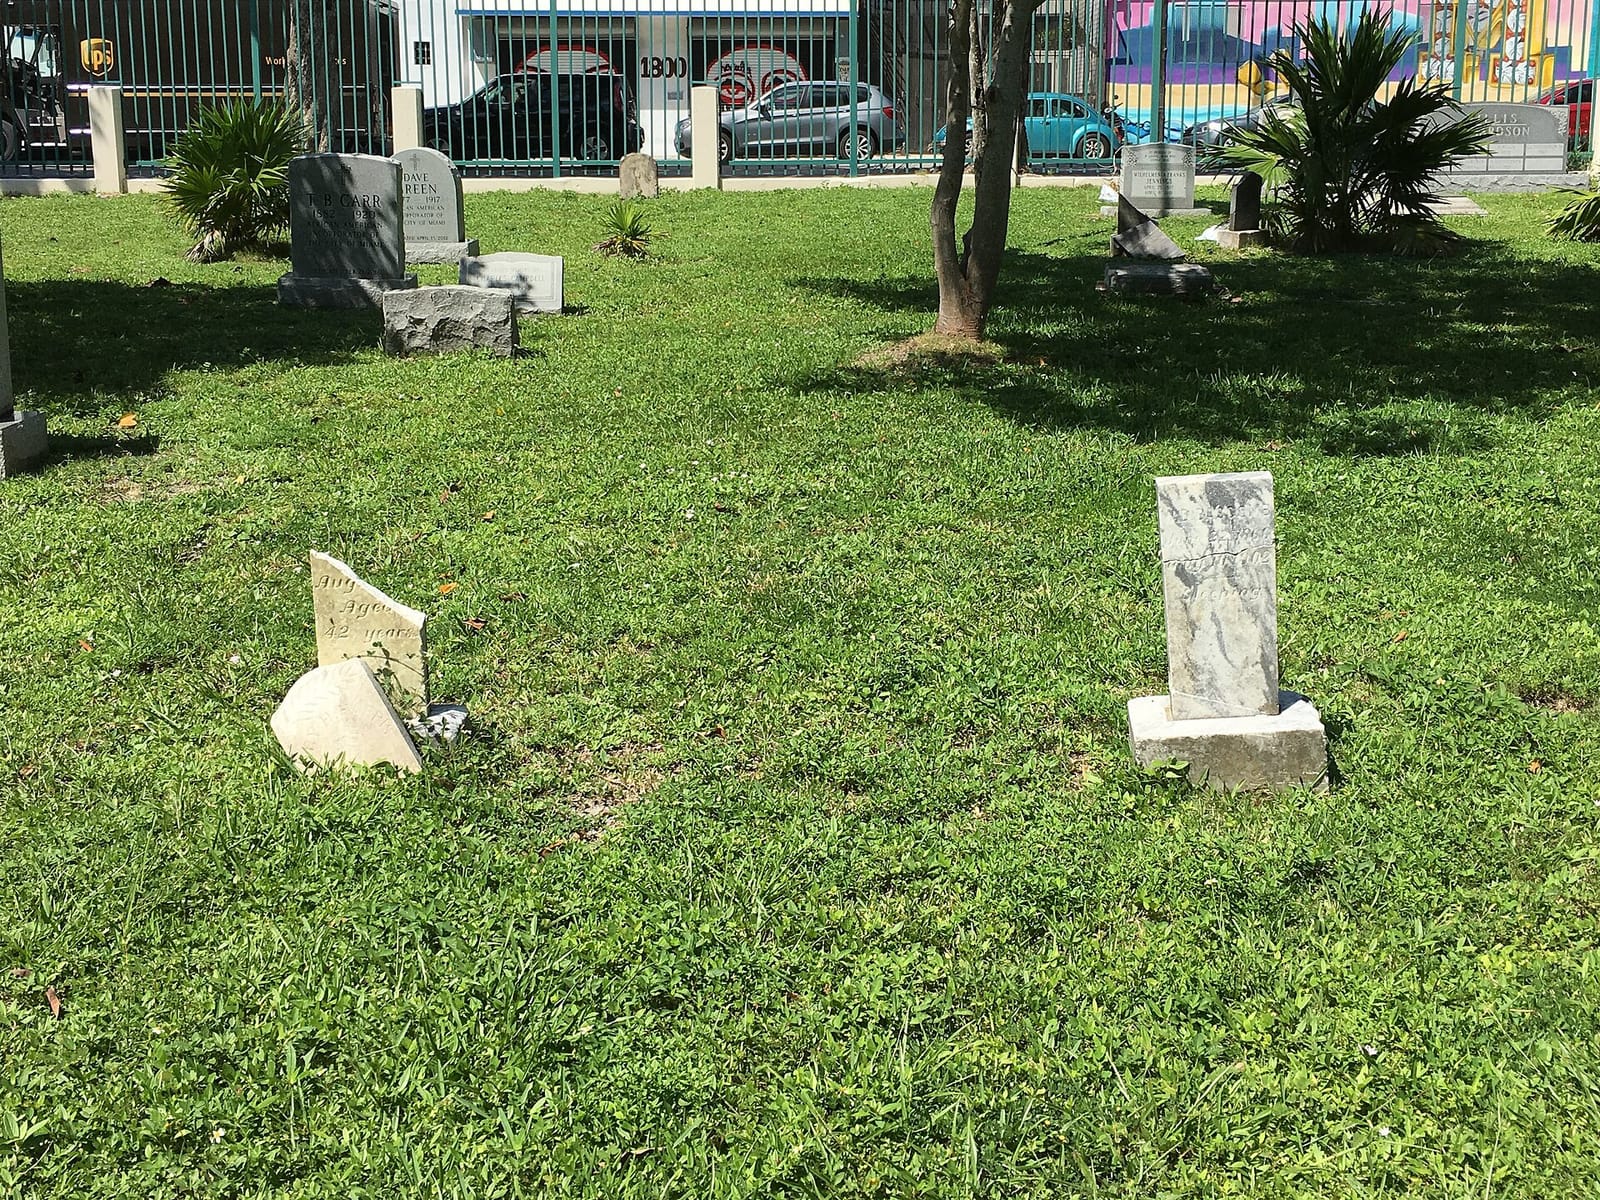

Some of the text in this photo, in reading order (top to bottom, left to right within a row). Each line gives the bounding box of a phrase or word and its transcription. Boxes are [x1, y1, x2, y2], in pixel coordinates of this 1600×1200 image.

[640, 56, 687, 78] 1800
[404, 173, 429, 182] DAVE
[405, 184, 437, 194] REEN
[323, 193, 333, 207] B
[340, 194, 382, 208] CARR
[352, 210, 376, 220] 1920
[315, 575, 357, 594] Aug
[324, 625, 350, 639] 42
